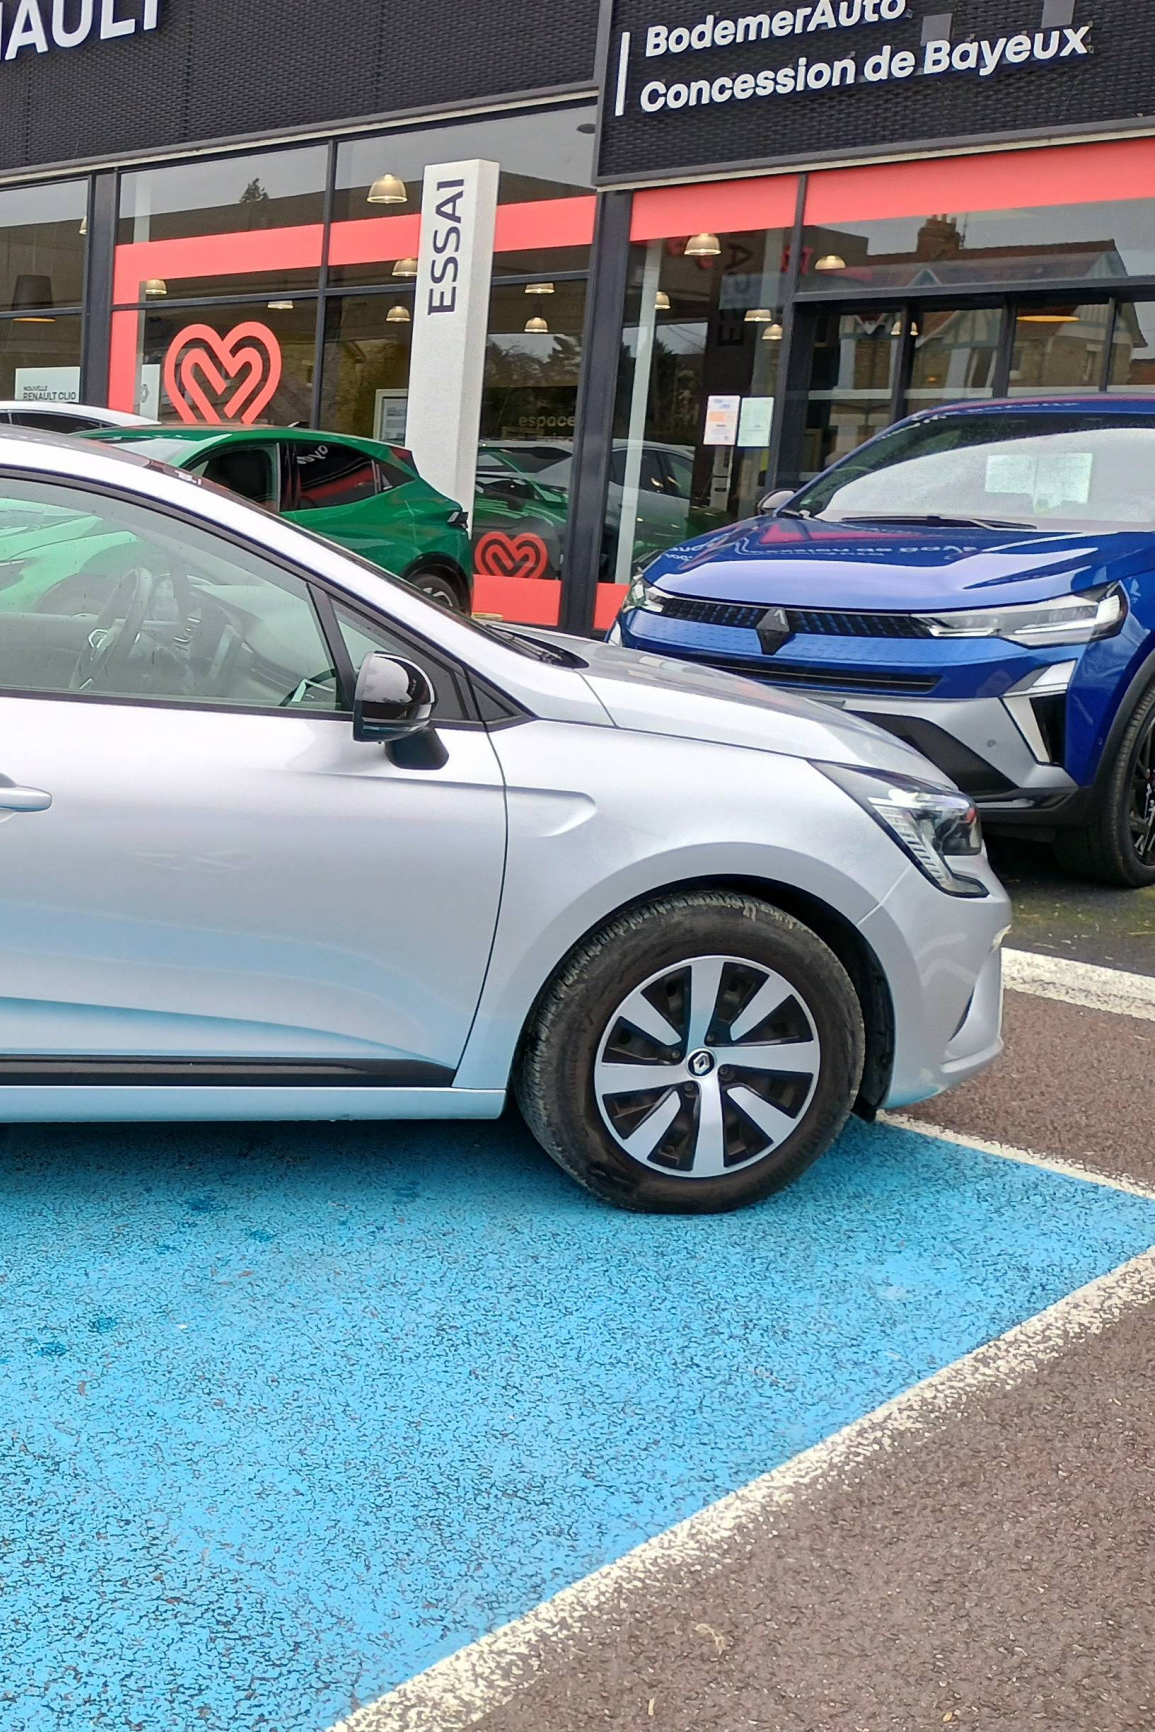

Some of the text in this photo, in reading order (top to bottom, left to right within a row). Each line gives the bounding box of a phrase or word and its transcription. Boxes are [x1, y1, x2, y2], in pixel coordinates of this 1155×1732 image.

[645, 0, 907, 57] BodemerAuto
[640, 26, 1091, 113] Concession de Bayeux
[427, 179, 465, 316] ESSAI
[23, 391, 77, 400] RENAULT CLIO
[518, 414, 576, 428] espace
